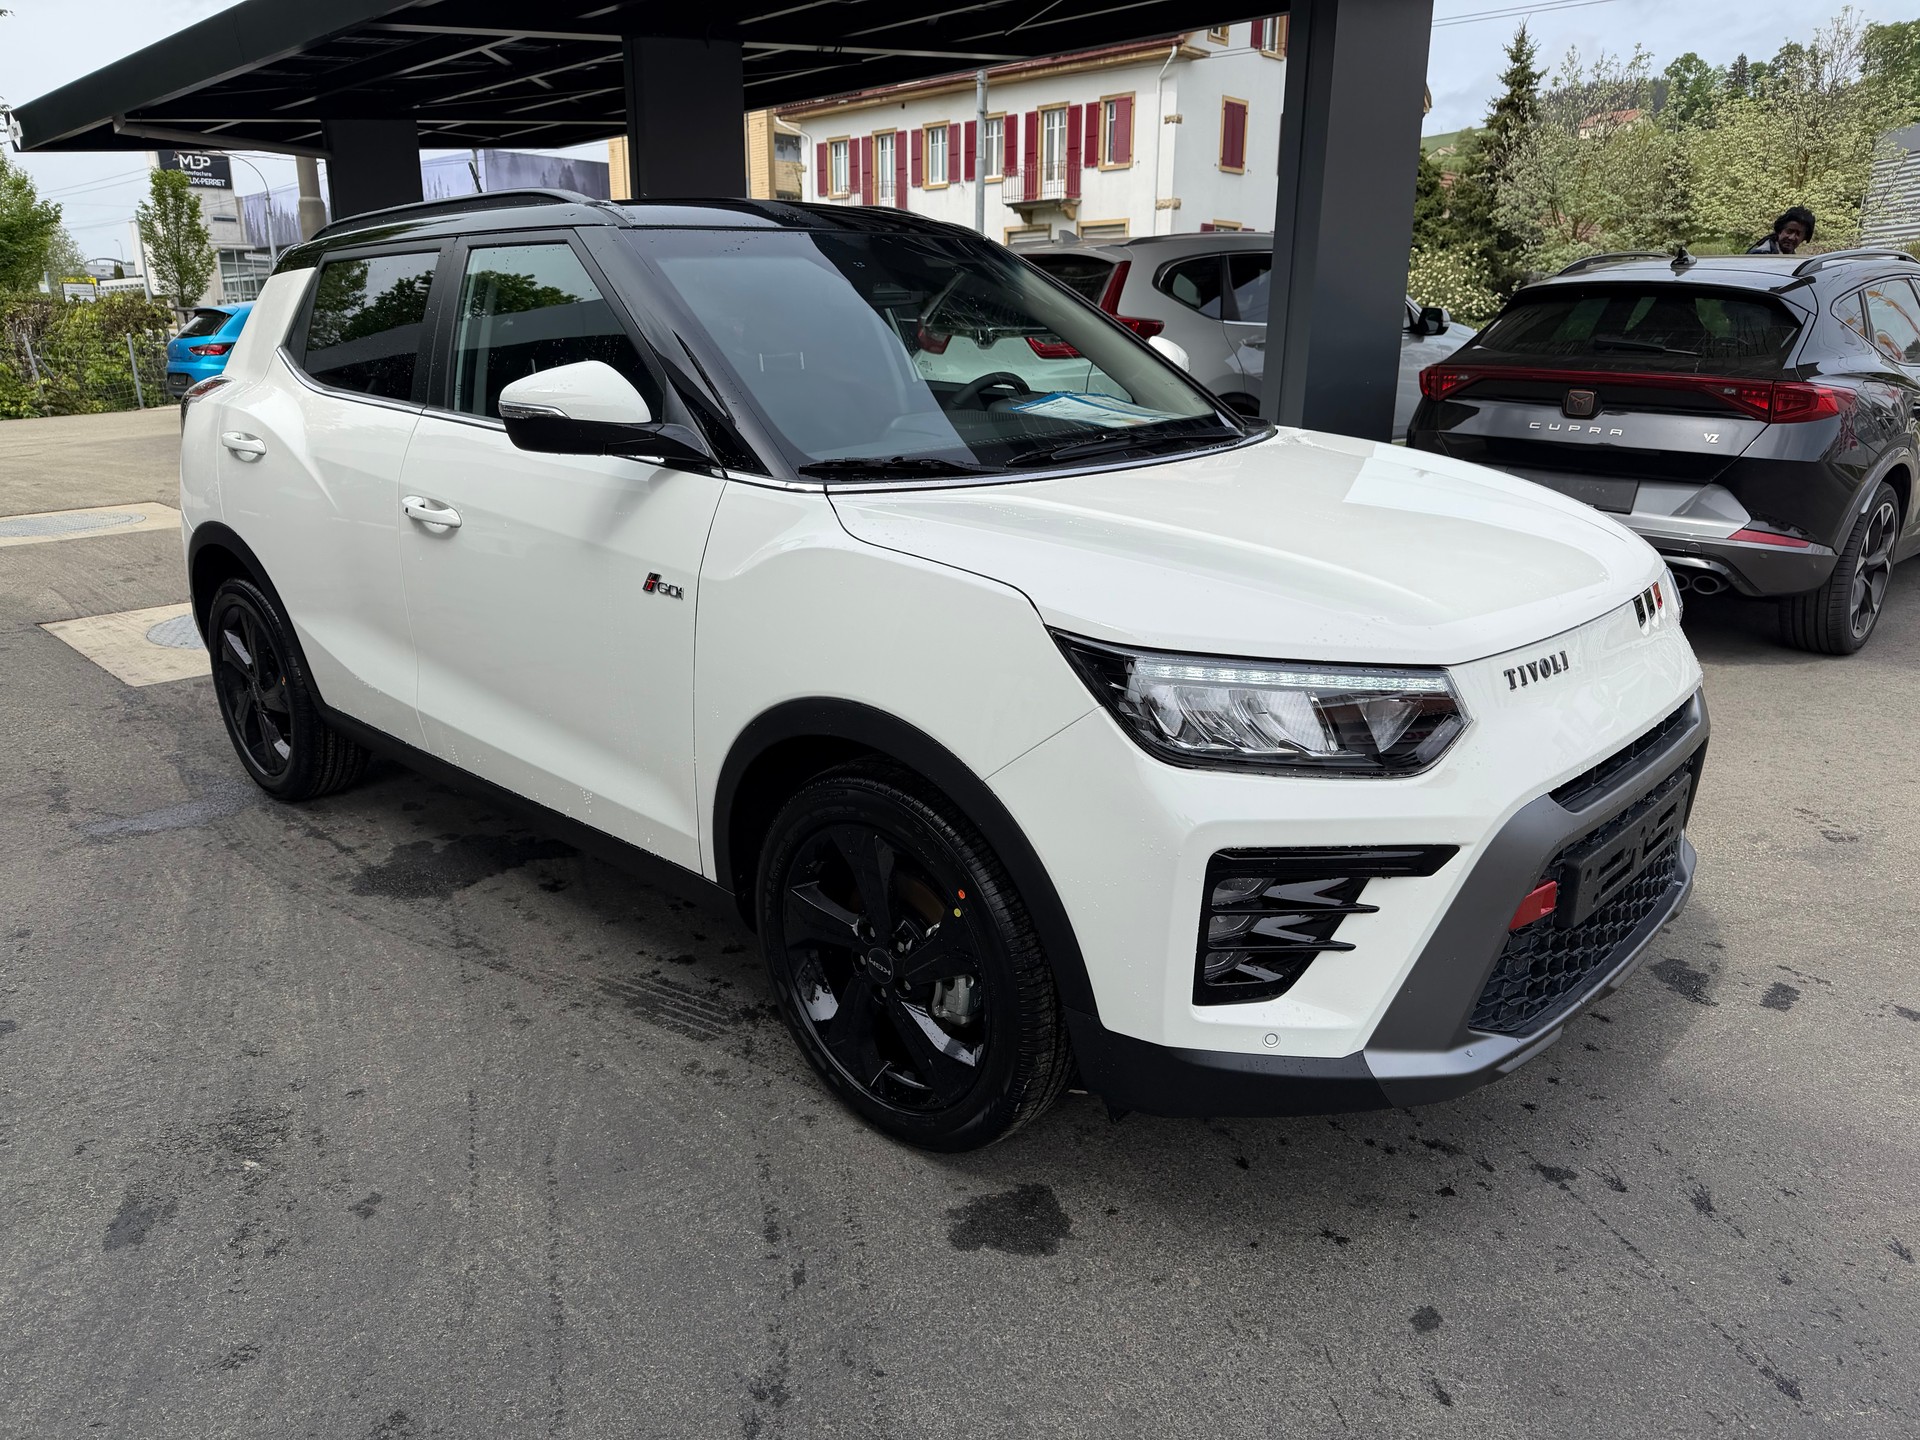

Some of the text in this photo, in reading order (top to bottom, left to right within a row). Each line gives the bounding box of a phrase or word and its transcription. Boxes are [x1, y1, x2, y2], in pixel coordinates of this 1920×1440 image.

[189, 177, 226, 187] UX-PERRET
[1529, 422, 1624, 436] CUPRA
[1703, 432, 1720, 445] VZ
[1503, 650, 1570, 691] TIVOLI
